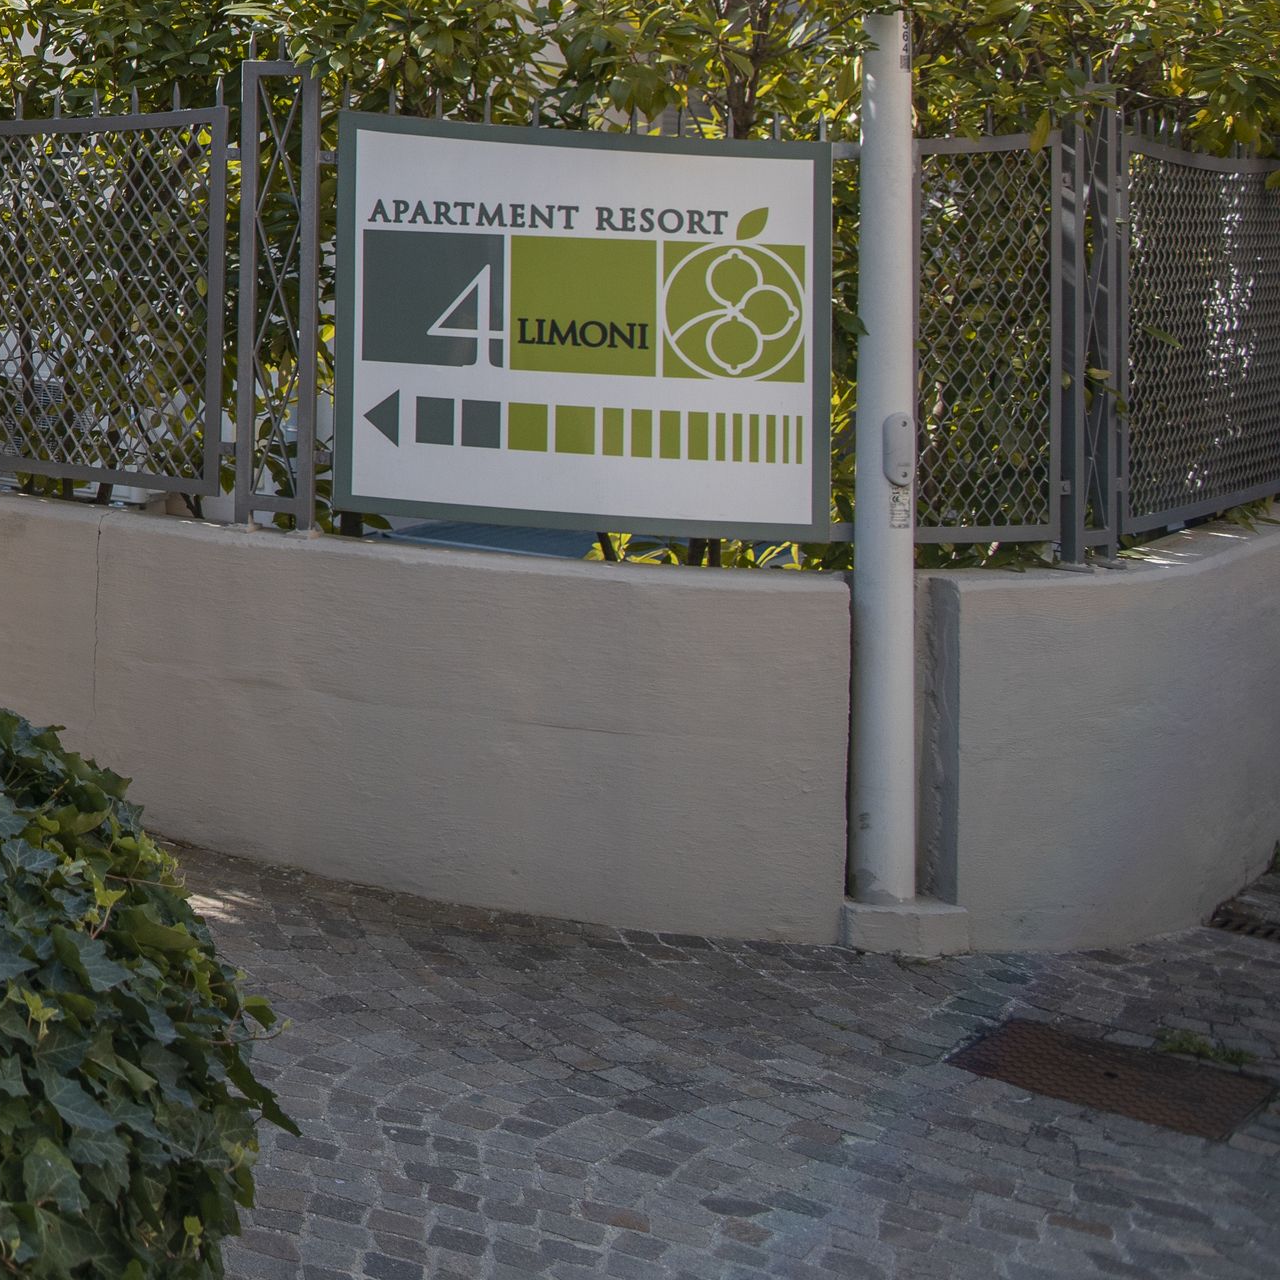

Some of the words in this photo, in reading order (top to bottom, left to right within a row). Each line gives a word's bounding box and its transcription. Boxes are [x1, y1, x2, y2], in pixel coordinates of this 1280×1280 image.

[367, 198, 580, 231] APARTMENT
[595, 206, 729, 235] RESORT
[426, 263, 505, 368] 4
[517, 318, 649, 351] LIMONI
